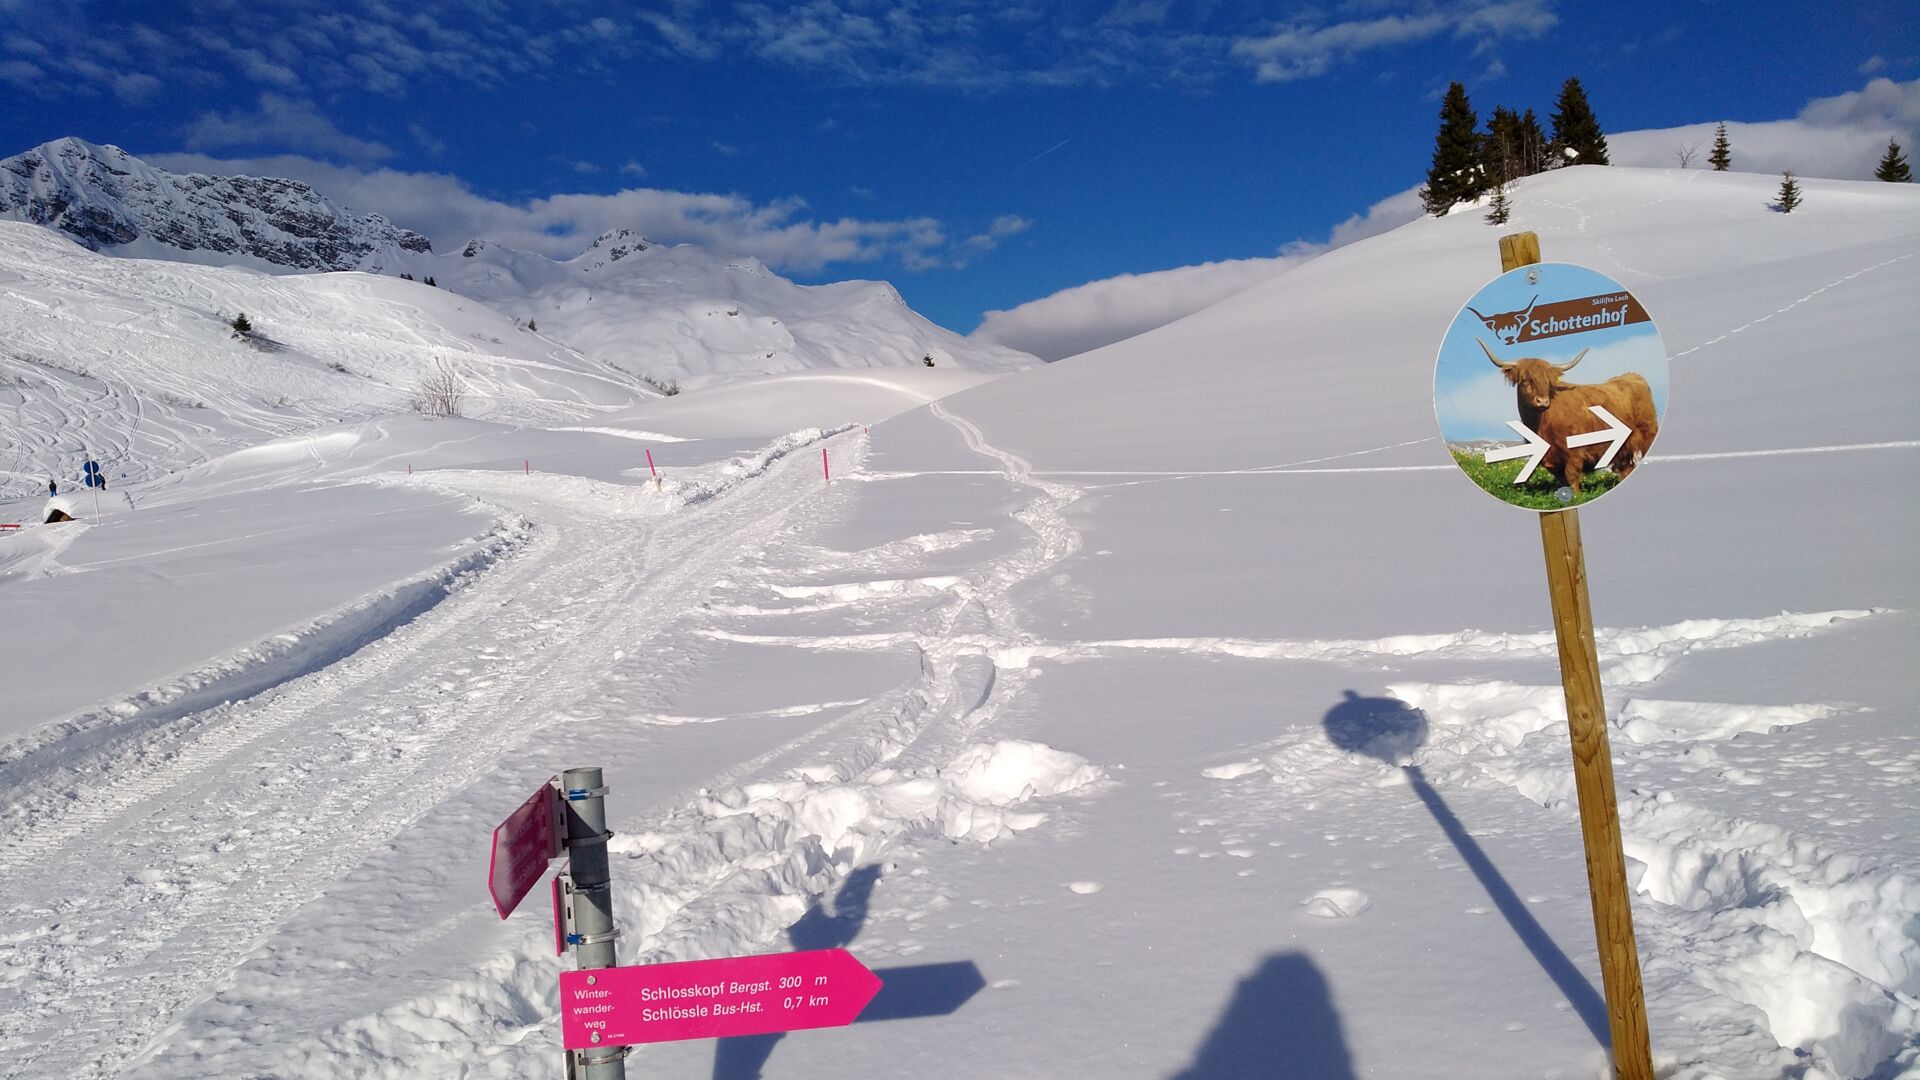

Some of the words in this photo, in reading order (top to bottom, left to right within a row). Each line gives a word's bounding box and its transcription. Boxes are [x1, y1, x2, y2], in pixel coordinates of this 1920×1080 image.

[1530, 304, 1628, 336] Schottenhof
[573, 989, 612, 1000] Winter-
[641, 981, 725, 1001] Schlosskopf
[729, 980, 772, 995] Bergst.
[778, 975, 802, 989] 300
[814, 975, 828, 986] m
[573, 1003, 615, 1015] wander-
[642, 1004, 708, 1022] Schlössle
[713, 1001, 764, 1016] Bus-Hst.
[783, 996, 803, 1010] 0,7
[809, 995, 829, 1007] km
[584, 1020, 606, 1030] weg
